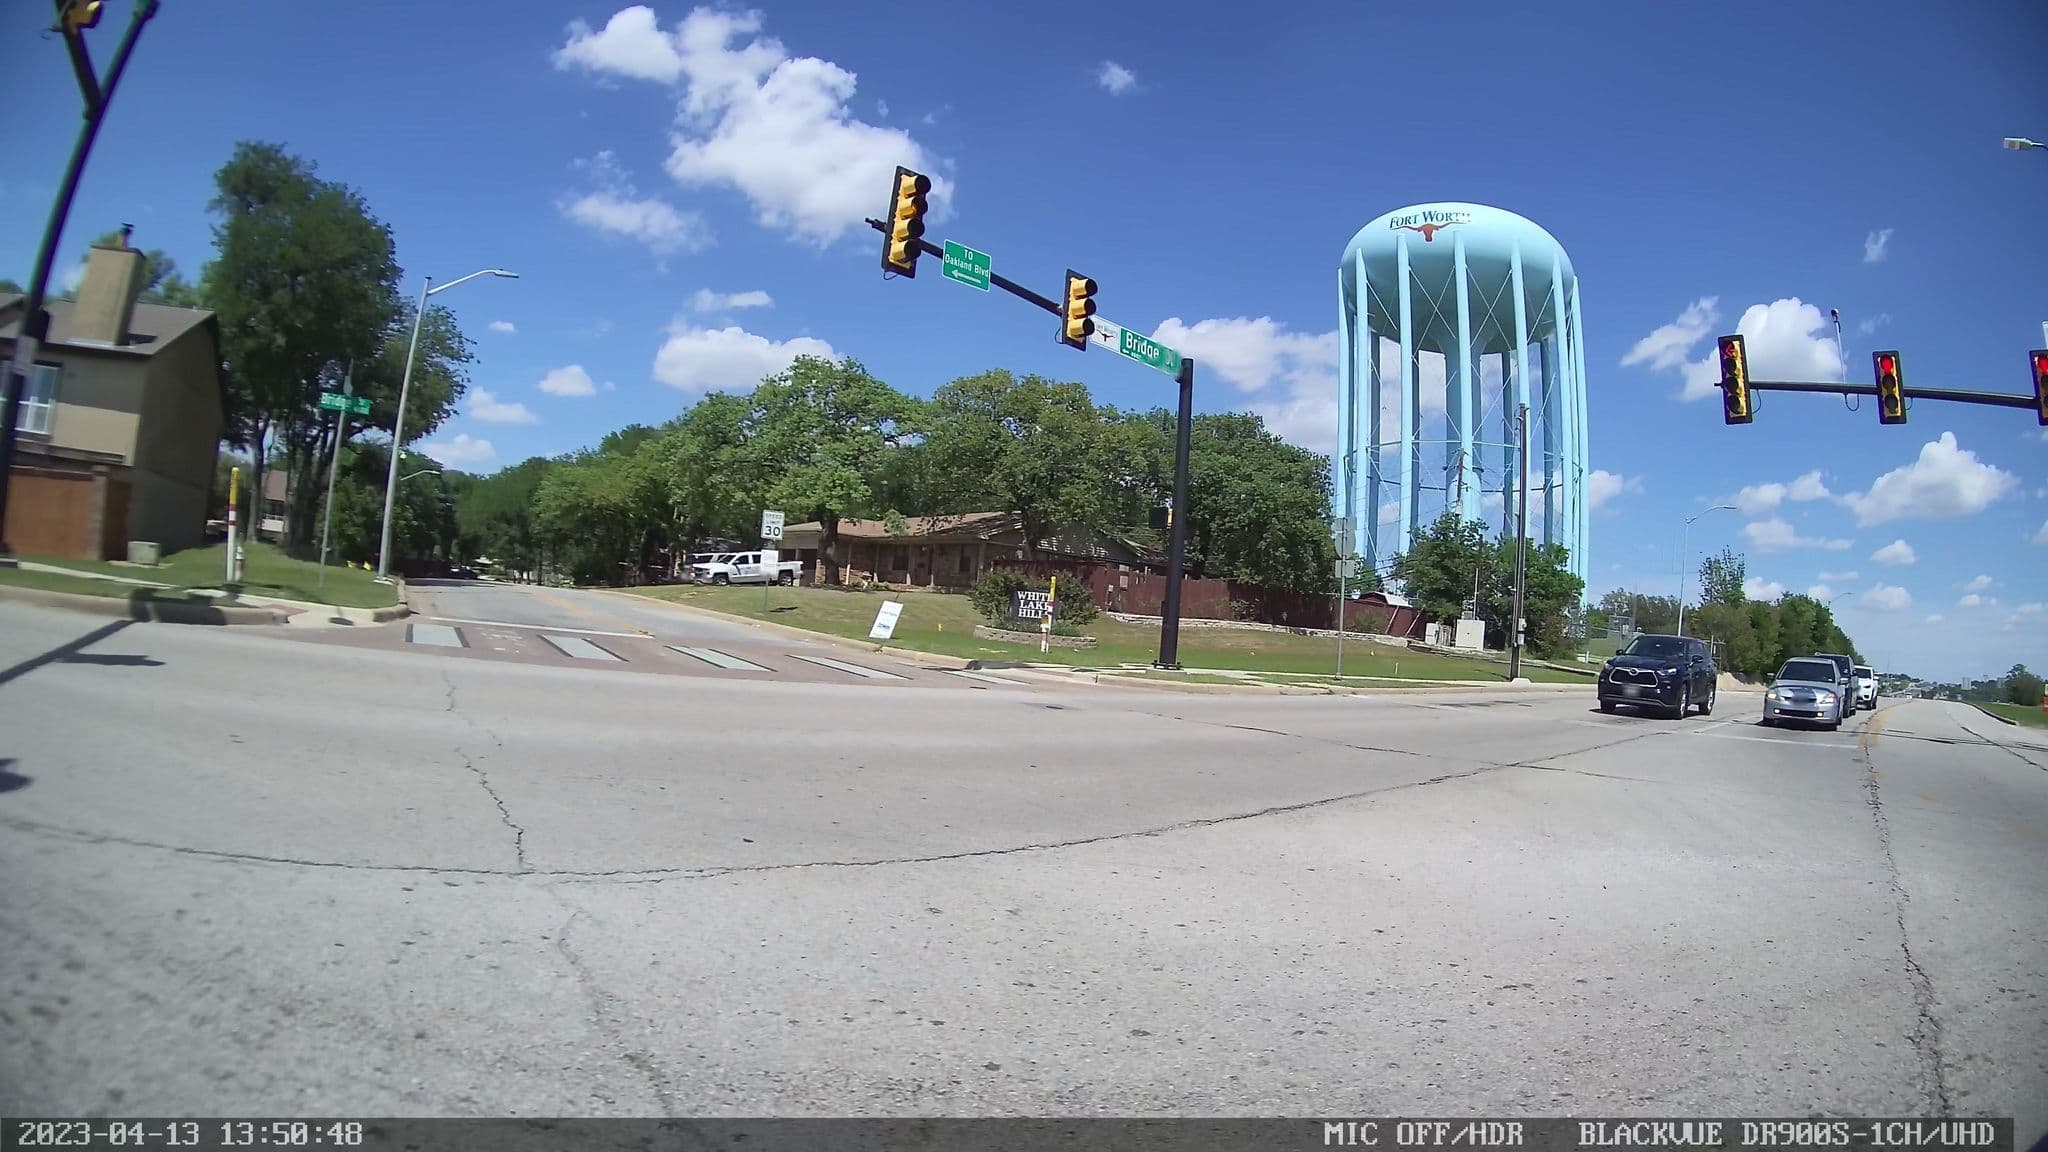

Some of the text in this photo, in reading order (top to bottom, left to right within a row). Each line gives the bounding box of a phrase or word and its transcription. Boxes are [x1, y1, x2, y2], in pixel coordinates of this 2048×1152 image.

[1390, 214, 1420, 228] FORT
[964, 249, 973, 260] TO
[945, 253, 989, 277] Oakland Blvd
[1126, 331, 1160, 359] Bridge
[765, 525, 780, 537] 30
[1018, 608, 1047, 619] HILL
